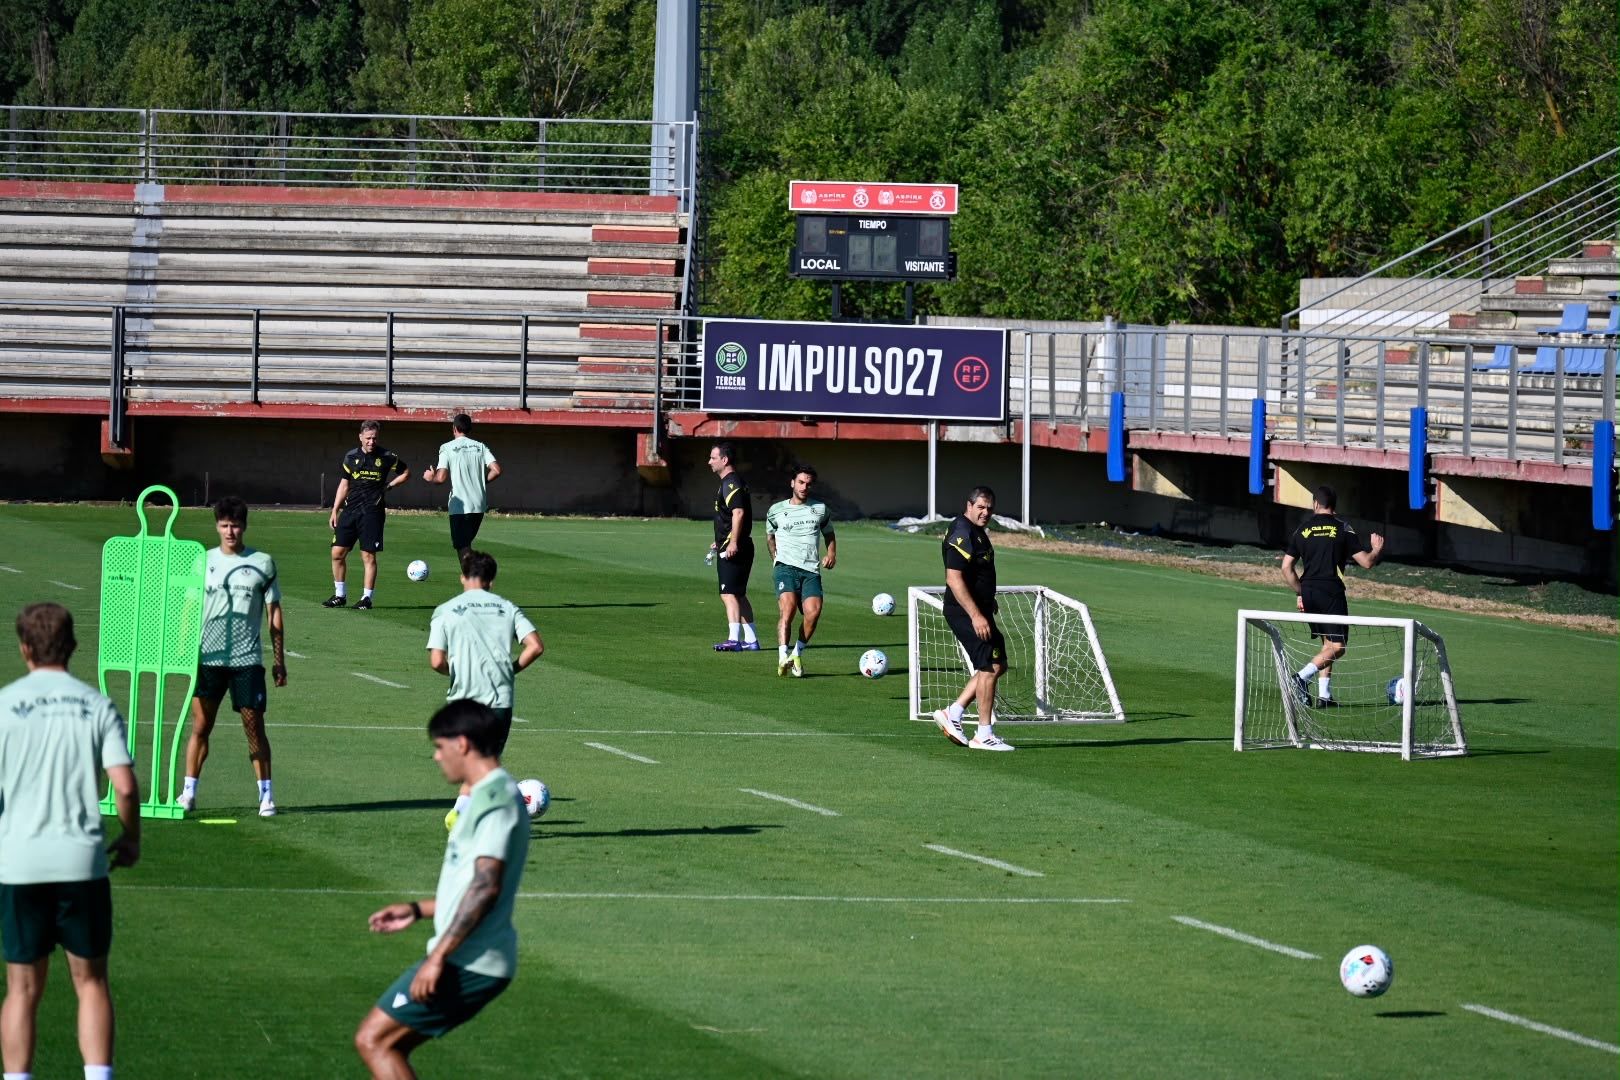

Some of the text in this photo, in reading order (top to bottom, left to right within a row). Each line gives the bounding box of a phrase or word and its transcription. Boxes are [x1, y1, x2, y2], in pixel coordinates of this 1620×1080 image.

[858, 220, 886, 230] TIEMPO
[800, 258, 840, 270] LOCAL
[904, 260, 944, 272] VISITANTE
[758, 342, 943, 396] IMPULSO27
[716, 376, 746, 386] TERCERA
